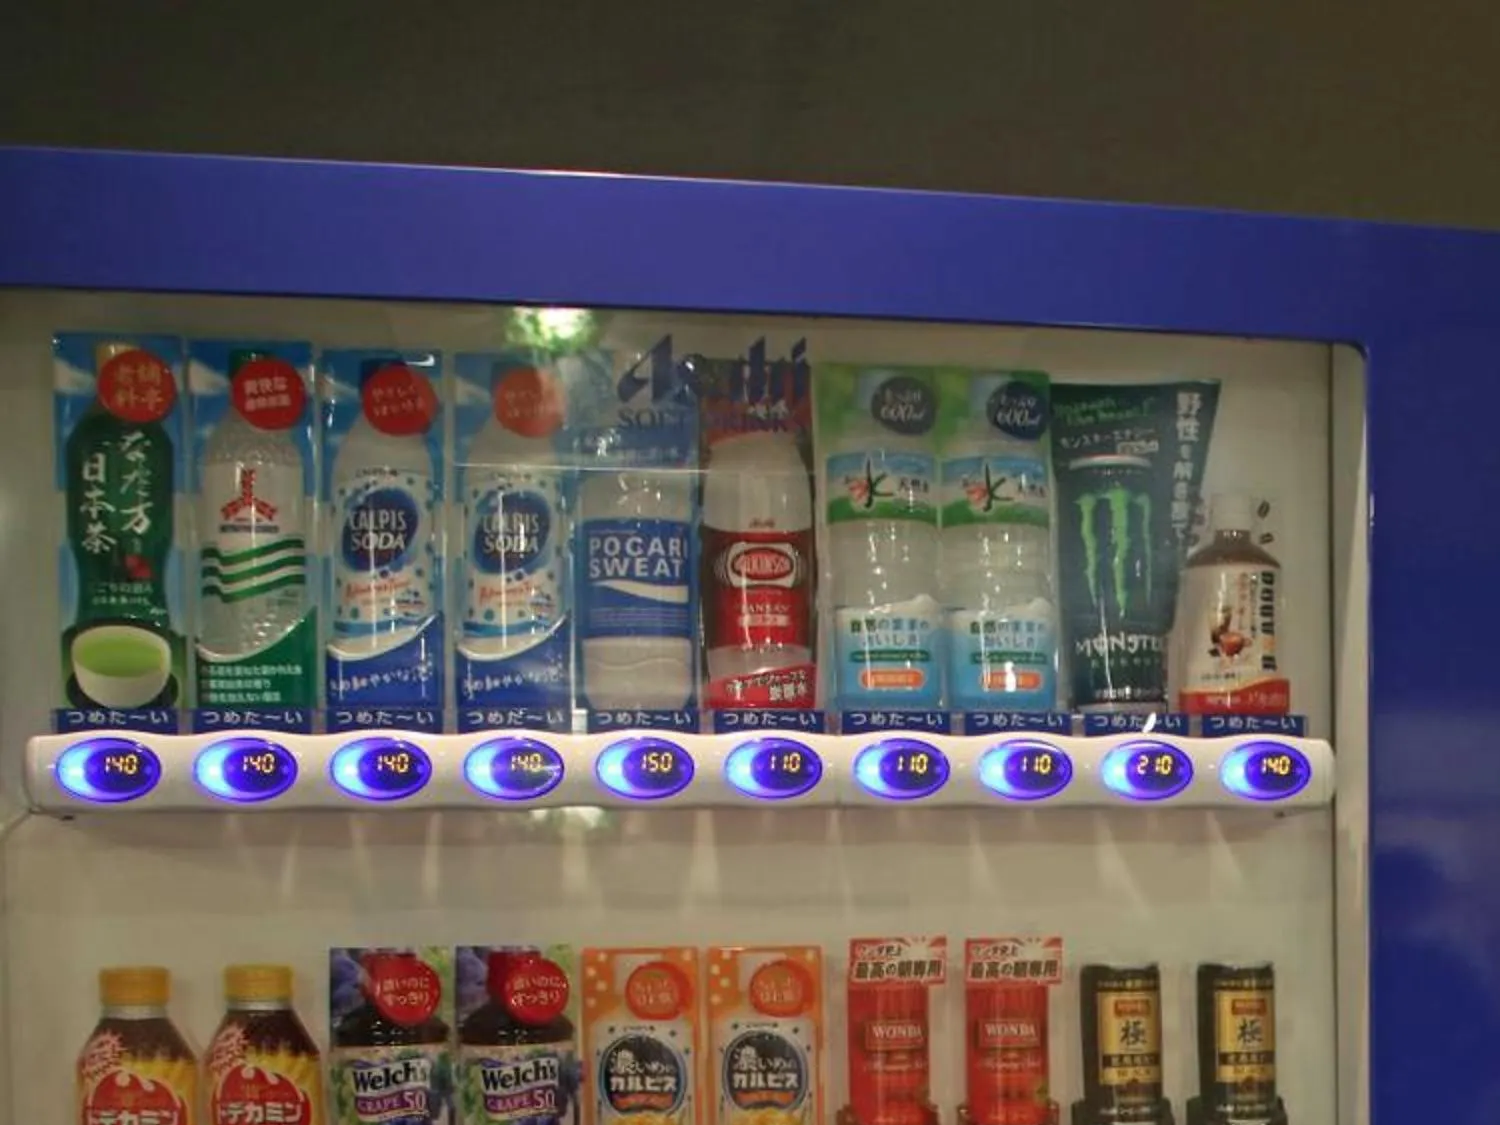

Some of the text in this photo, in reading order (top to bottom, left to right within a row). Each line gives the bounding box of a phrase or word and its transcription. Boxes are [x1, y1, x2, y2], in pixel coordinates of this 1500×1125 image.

[350, 509, 408, 531] CALPIS
[483, 512, 540, 534] CALPIS
[351, 532, 408, 551] SODA
[484, 534, 540, 553] SODA
[589, 537, 687, 579] POCARI SWEAT
[104, 753, 139, 775] 140
[242, 752, 276, 774] 140
[377, 752, 411, 774] 140
[510, 752, 545, 774] 140
[640, 751, 674, 773] 150
[770, 751, 802, 773] 110
[897, 753, 929, 775] 110
[1021, 753, 1052, 775] 110
[1136, 754, 1174, 776] 210
[1261, 754, 1292, 776] 140
[352, 1058, 429, 1093] Welch's
[482, 1057, 558, 1092] Welch's
[610, 1074, 677, 1093] カルピス
[732, 1071, 799, 1089] カルピス
[403, 1090, 427, 1111] 50
[532, 1089, 556, 1110] 50
